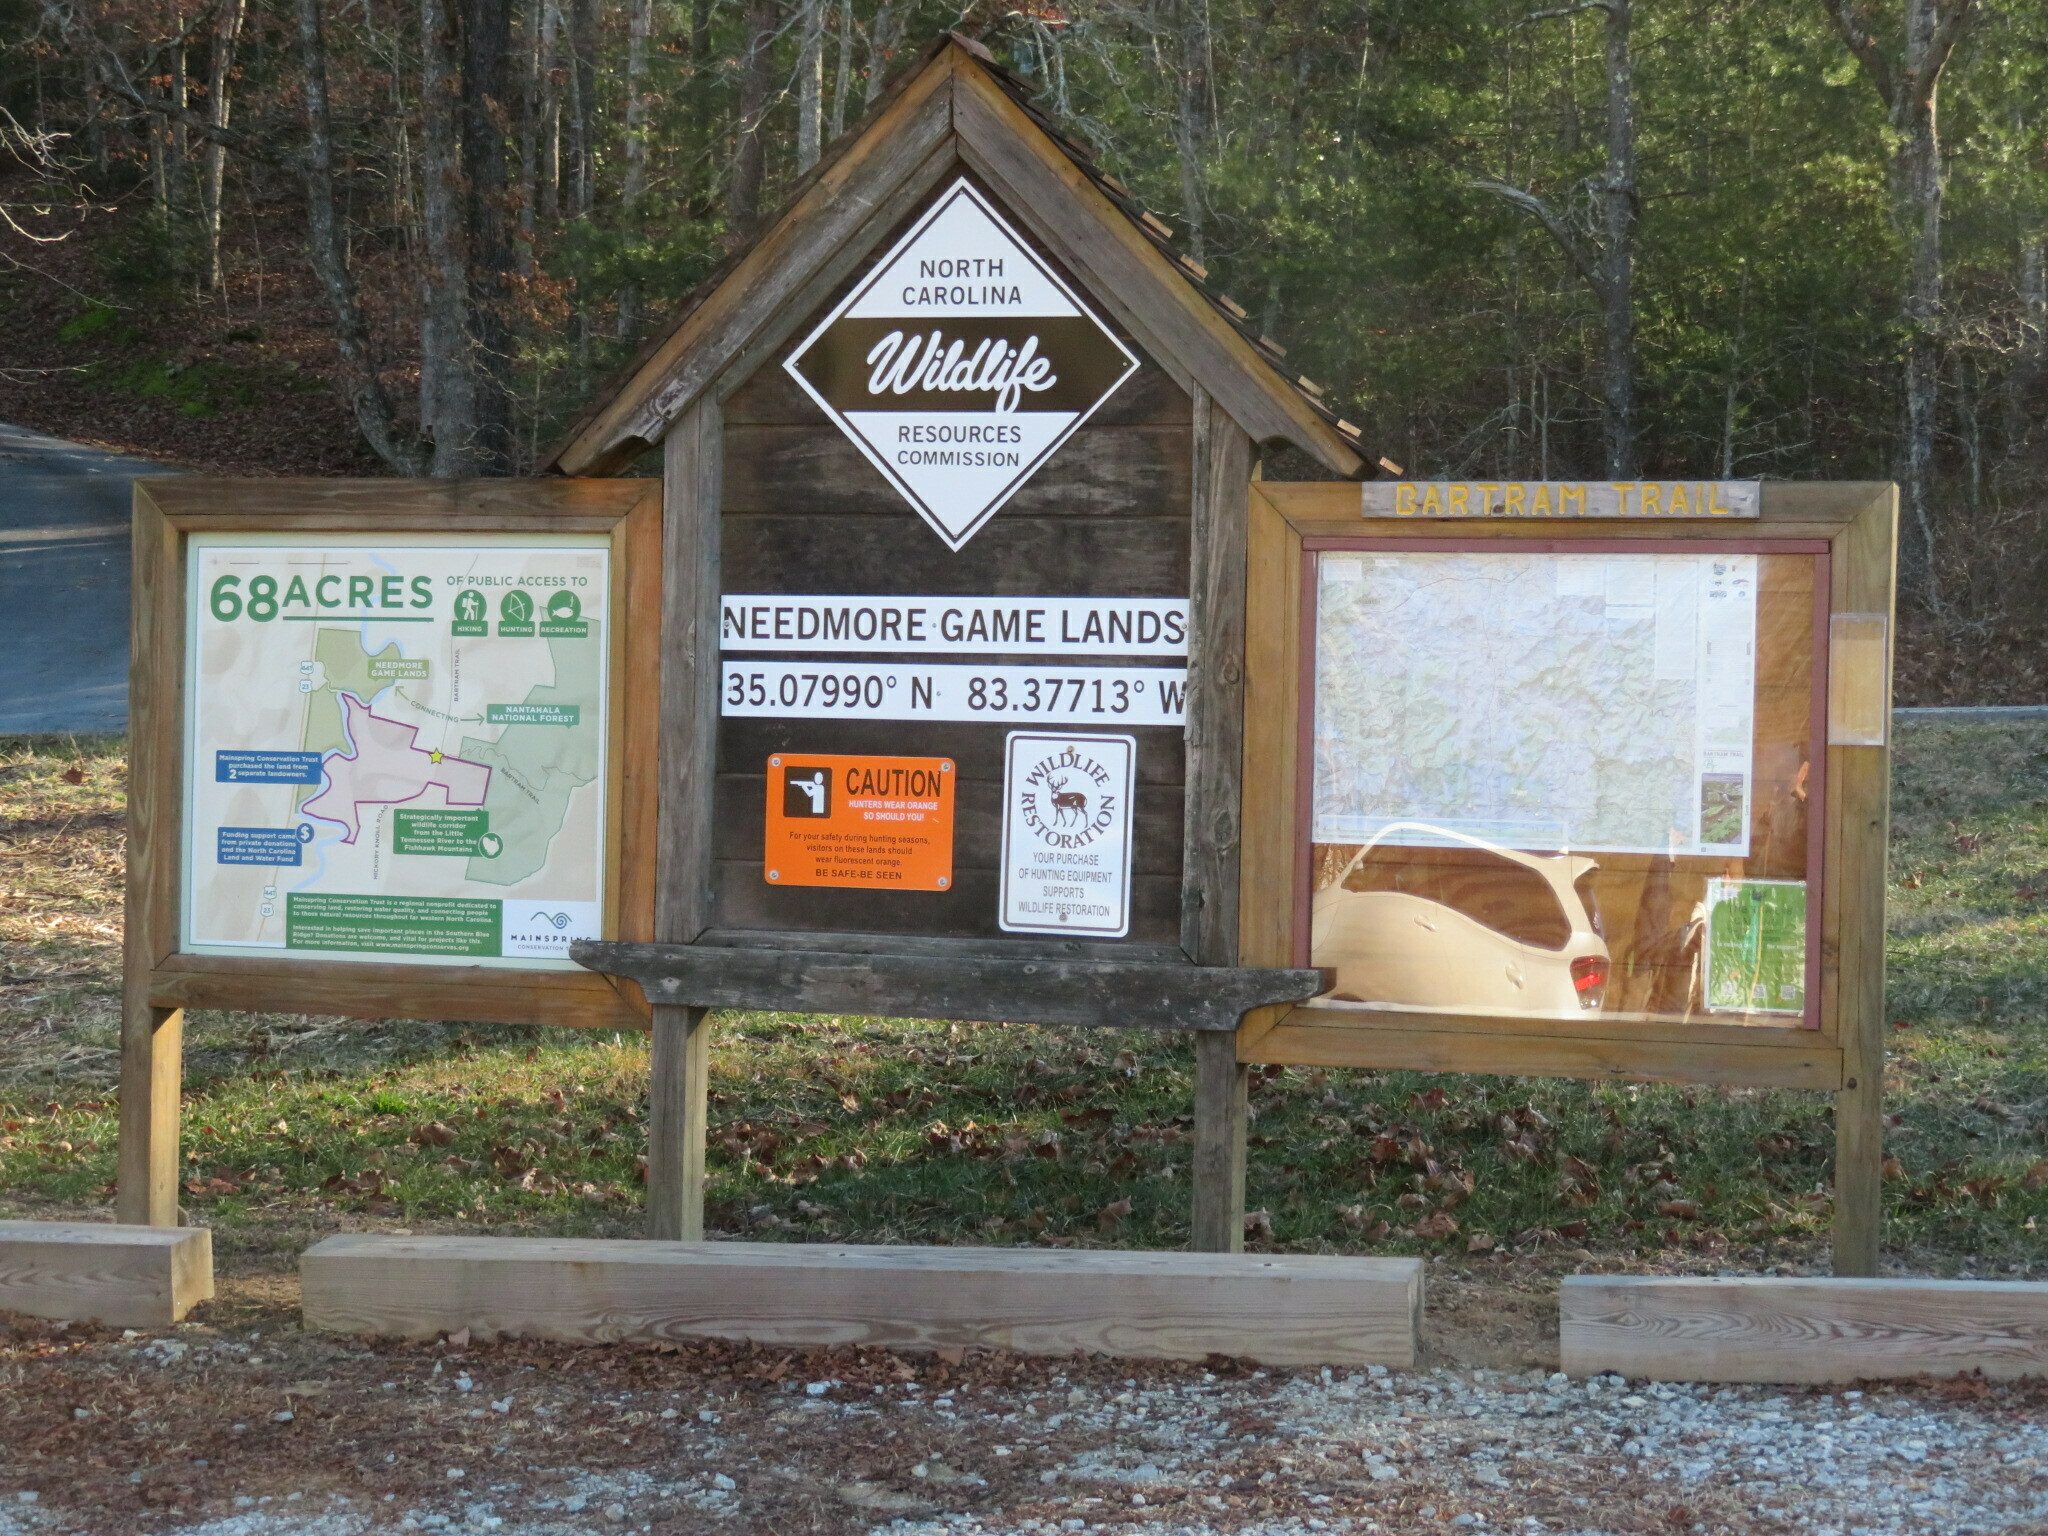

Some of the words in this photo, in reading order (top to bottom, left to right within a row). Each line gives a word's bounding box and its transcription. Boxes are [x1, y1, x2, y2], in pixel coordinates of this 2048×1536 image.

[920, 259, 1004, 279] NORTH
[902, 286, 1022, 305] CAROLINA
[867, 330, 1057, 413] Wildlife
[898, 425, 1022, 444] RESOURCES
[897, 450, 1020, 466] COMMISSION
[1396, 483, 1586, 515] BARTRAM
[1612, 483, 1729, 515] TRAIL
[447, 576, 464, 585] OF
[468, 576, 513, 585] PUBLIC
[517, 577, 566, 586] ACCESS
[571, 577, 588, 586] TO
[210, 575, 279, 622] 68
[282, 575, 433, 608] ACRES
[724, 607, 926, 641] NEEDMORE
[941, 608, 1045, 643] GAME
[1062, 610, 1184, 644] LANDS
[728, 673, 897, 709] 35.07990°
[912, 676, 932, 709] N
[968, 677, 1144, 714] 83.37713°
[1159, 681, 1187, 714] W
[410, 701, 459, 723] CONNECTING
[229, 770, 236, 779] 2
[1026, 753, 1110, 787] WILDLIFE
[501, 767, 526, 790] BARTRAM
[522, 788, 540, 805] TRAIL
[846, 768, 941, 797] CAUTION
[849, 800, 882, 809] HUNTERS
[884, 801, 905, 809] WEAR
[907, 802, 938, 810] ORANGE
[864, 812, 874, 820] SO
[876, 812, 904, 820] SHOULD
[907, 813, 924, 821] YOU!
[1021, 792, 1115, 848] RESTORATION
[821, 833, 842, 842] safety
[845, 834, 866, 843] during
[870, 835, 896, 844] hunting
[898, 836, 929, 845] seasons,
[846, 845, 864, 853] these
[834, 856, 873, 864] fluorescent
[876, 858, 902, 867] orange.
[1033, 852, 1054, 863] YOUR
[1057, 854, 1099, 866] PURCHASE
[1019, 868, 1029, 878] OF
[1031, 869, 1065, 880] HUNTING
[1067, 871, 1112, 883] EQUIPMENT
[1043, 886, 1084, 898] SUPPORTS
[1019, 902, 1053, 913] WILDLIFE
[1056, 903, 1110, 916] RESTORATION
